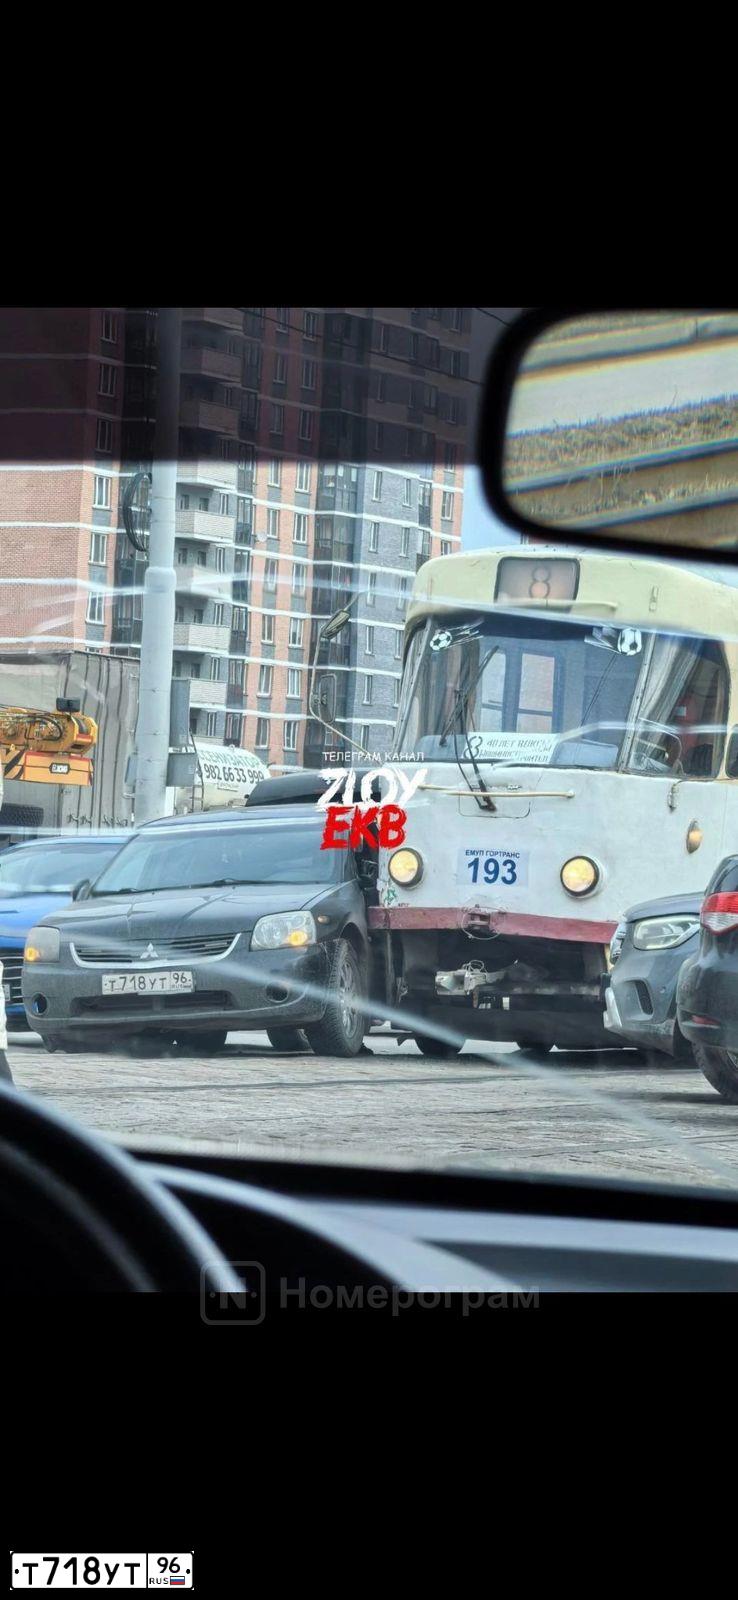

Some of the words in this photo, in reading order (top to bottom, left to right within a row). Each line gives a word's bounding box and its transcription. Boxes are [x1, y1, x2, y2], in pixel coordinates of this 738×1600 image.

[529, 566, 551, 599] 8
[203, 763, 222, 780] 982
[222, 766, 235, 782] 66
[234, 767, 247, 782] 33
[247, 769, 265, 784] 999
[485, 850, 520, 859] ГОРТРАНС
[467, 857, 517, 885] 193
[172, 972, 187, 983] 96
